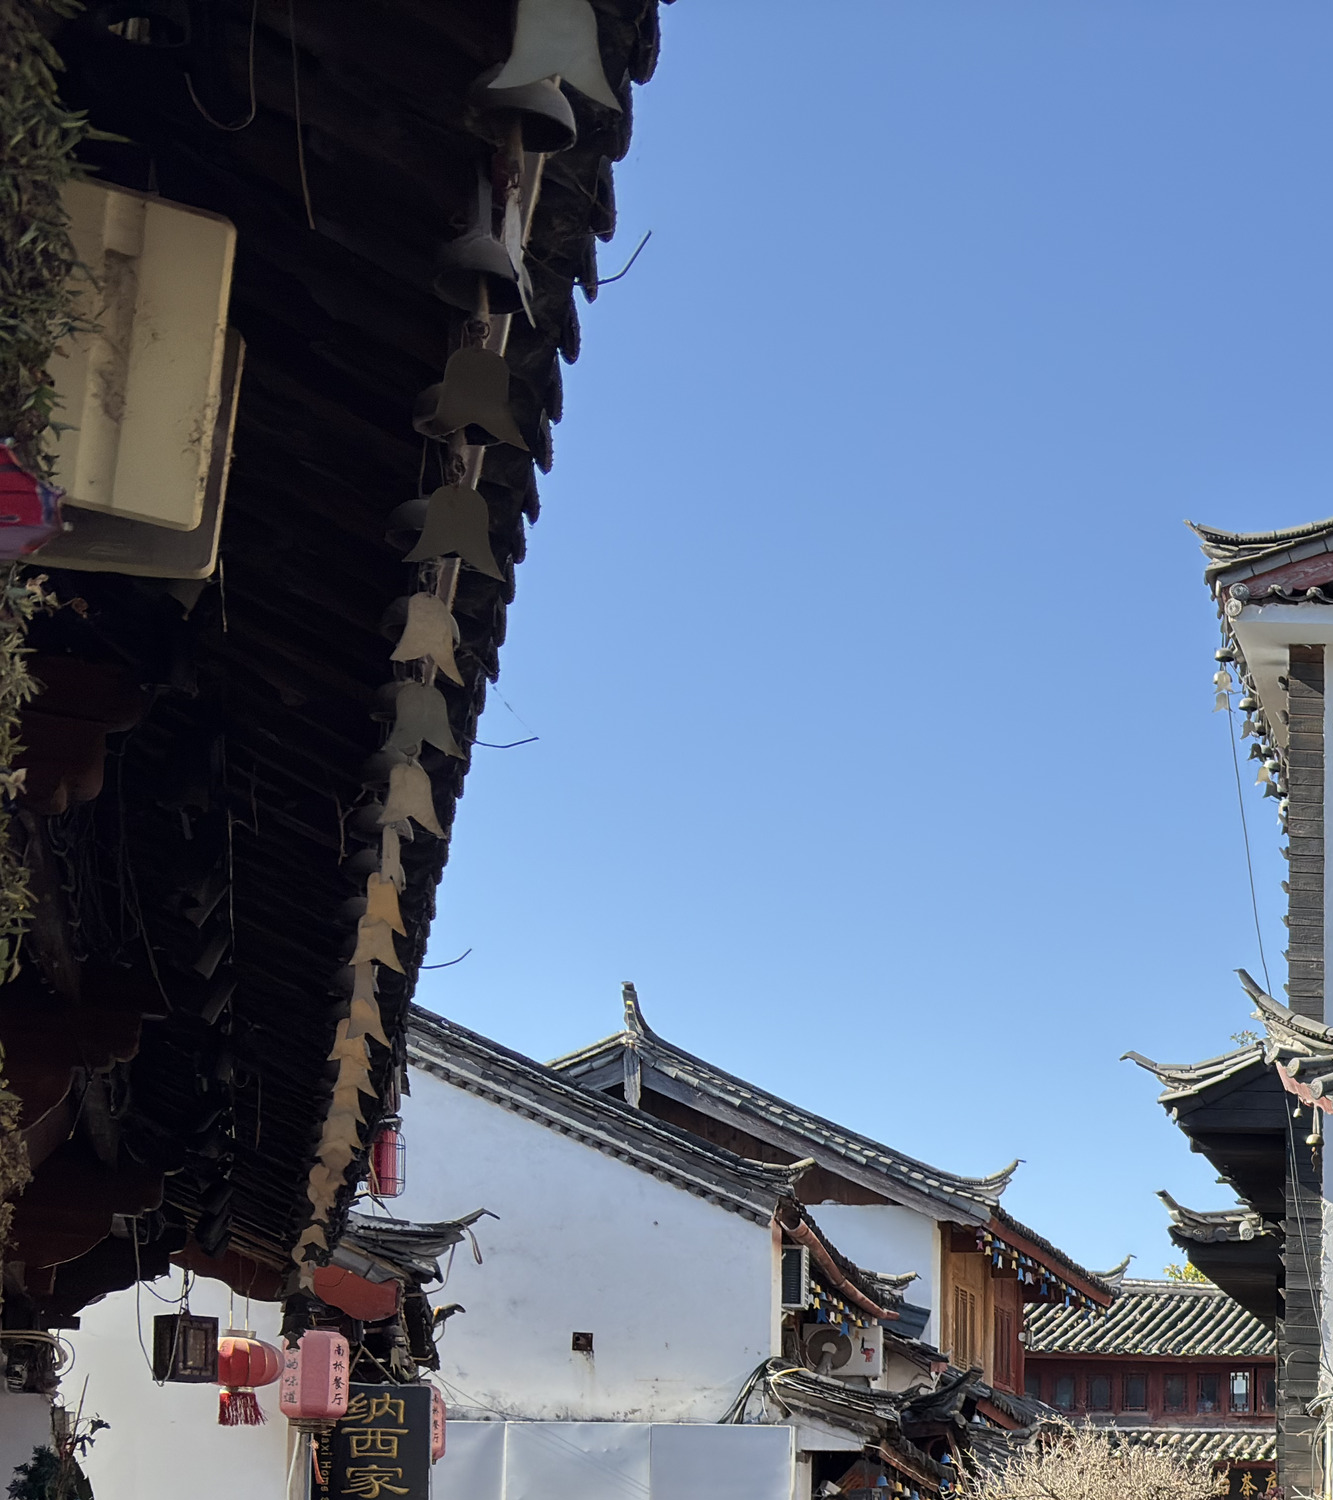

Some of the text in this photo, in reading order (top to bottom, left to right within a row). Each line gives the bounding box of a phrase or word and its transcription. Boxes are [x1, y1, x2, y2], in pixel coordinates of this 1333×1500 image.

[284, 1349, 299, 1404] 的味道
[332, 1343, 346, 1406] 南桥餐厅
[320, 1461, 332, 1492] Home
